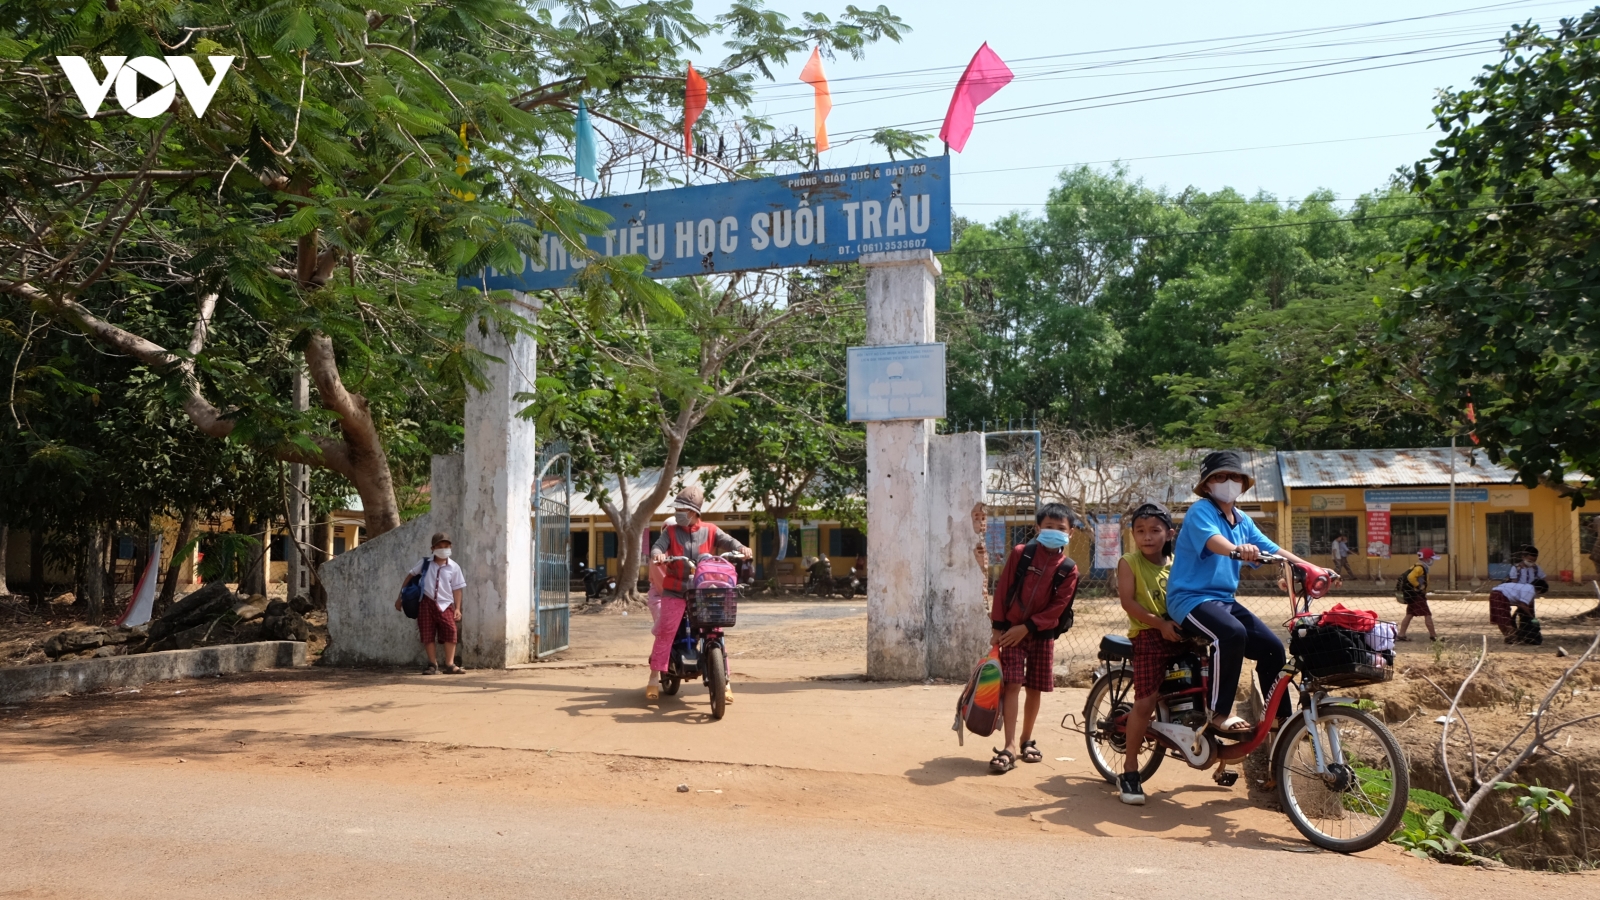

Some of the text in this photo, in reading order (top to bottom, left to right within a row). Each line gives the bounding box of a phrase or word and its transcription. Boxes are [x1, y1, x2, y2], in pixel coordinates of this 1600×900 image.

[788, 176, 817, 188] PHÒNG
[824, 172, 846, 183] GIÁO
[851, 170, 870, 182] DỤC
[874, 170, 881, 178] &
[886, 166, 905, 176] ĐÀO
[602, 210, 665, 260] TIỂU
[676, 216, 738, 258] HỌC
[751, 192, 826, 250] SUỐI
[843, 183, 930, 241] TRẦU
